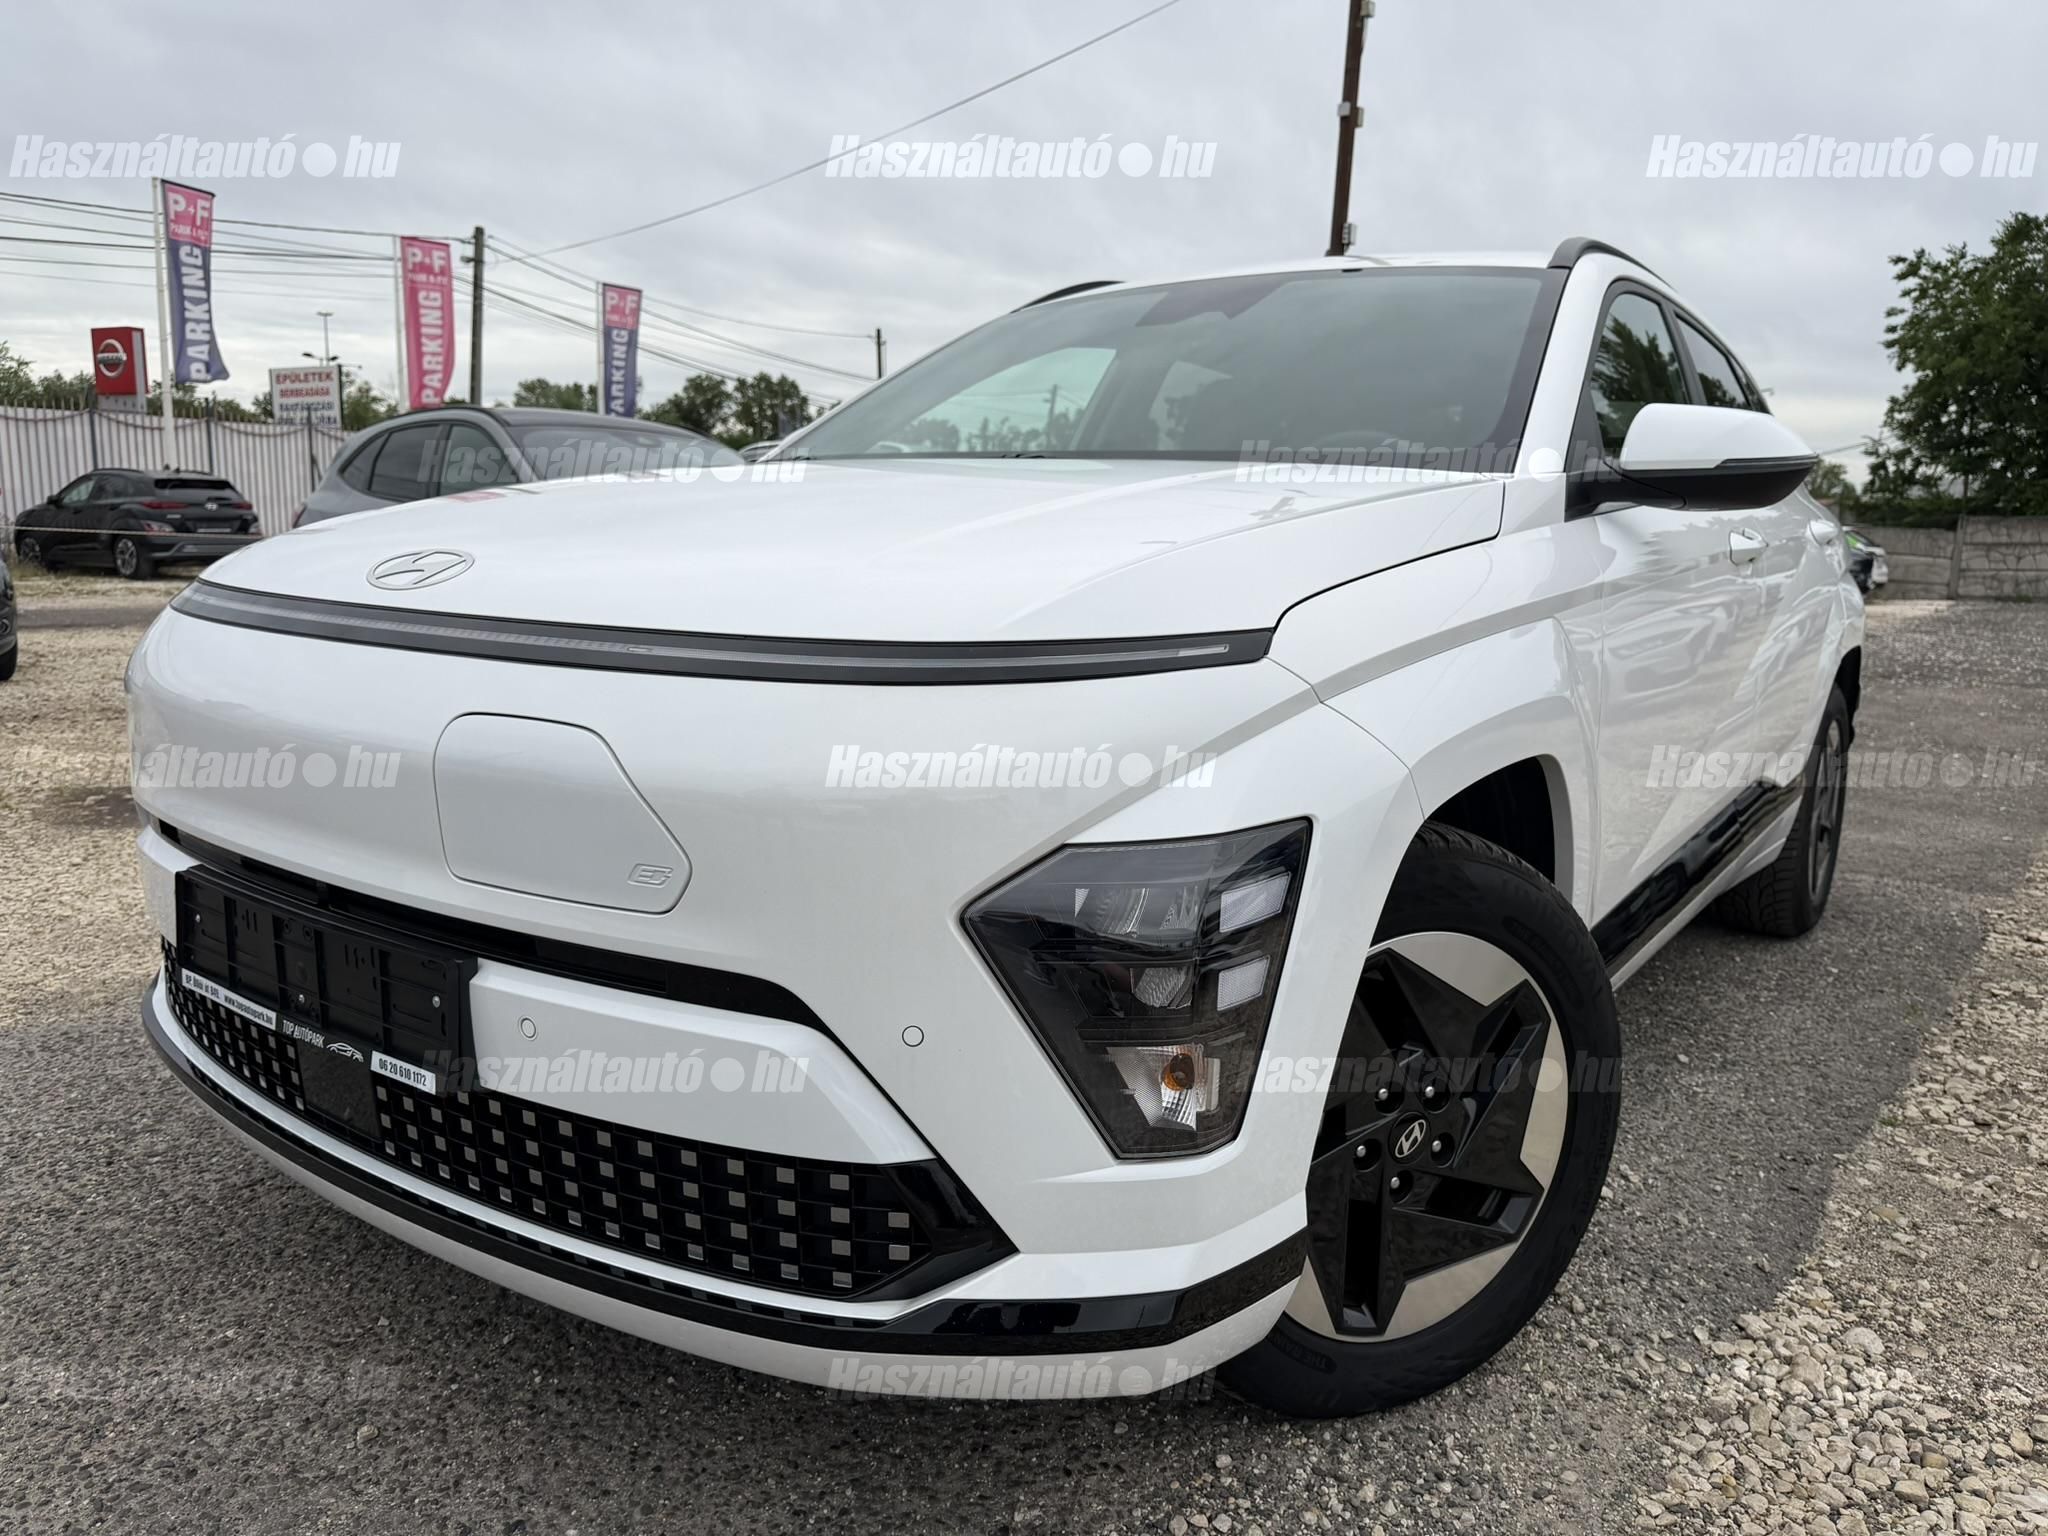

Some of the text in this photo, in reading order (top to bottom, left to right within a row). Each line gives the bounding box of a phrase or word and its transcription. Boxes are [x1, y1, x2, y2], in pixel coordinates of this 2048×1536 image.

[179, 244, 211, 381] PARKING
[418, 289, 443, 404] PARKING
[282, 1020, 326, 1049] TOP AUTÓPARK
[379, 1058, 427, 1087] 06 20 610 1172
